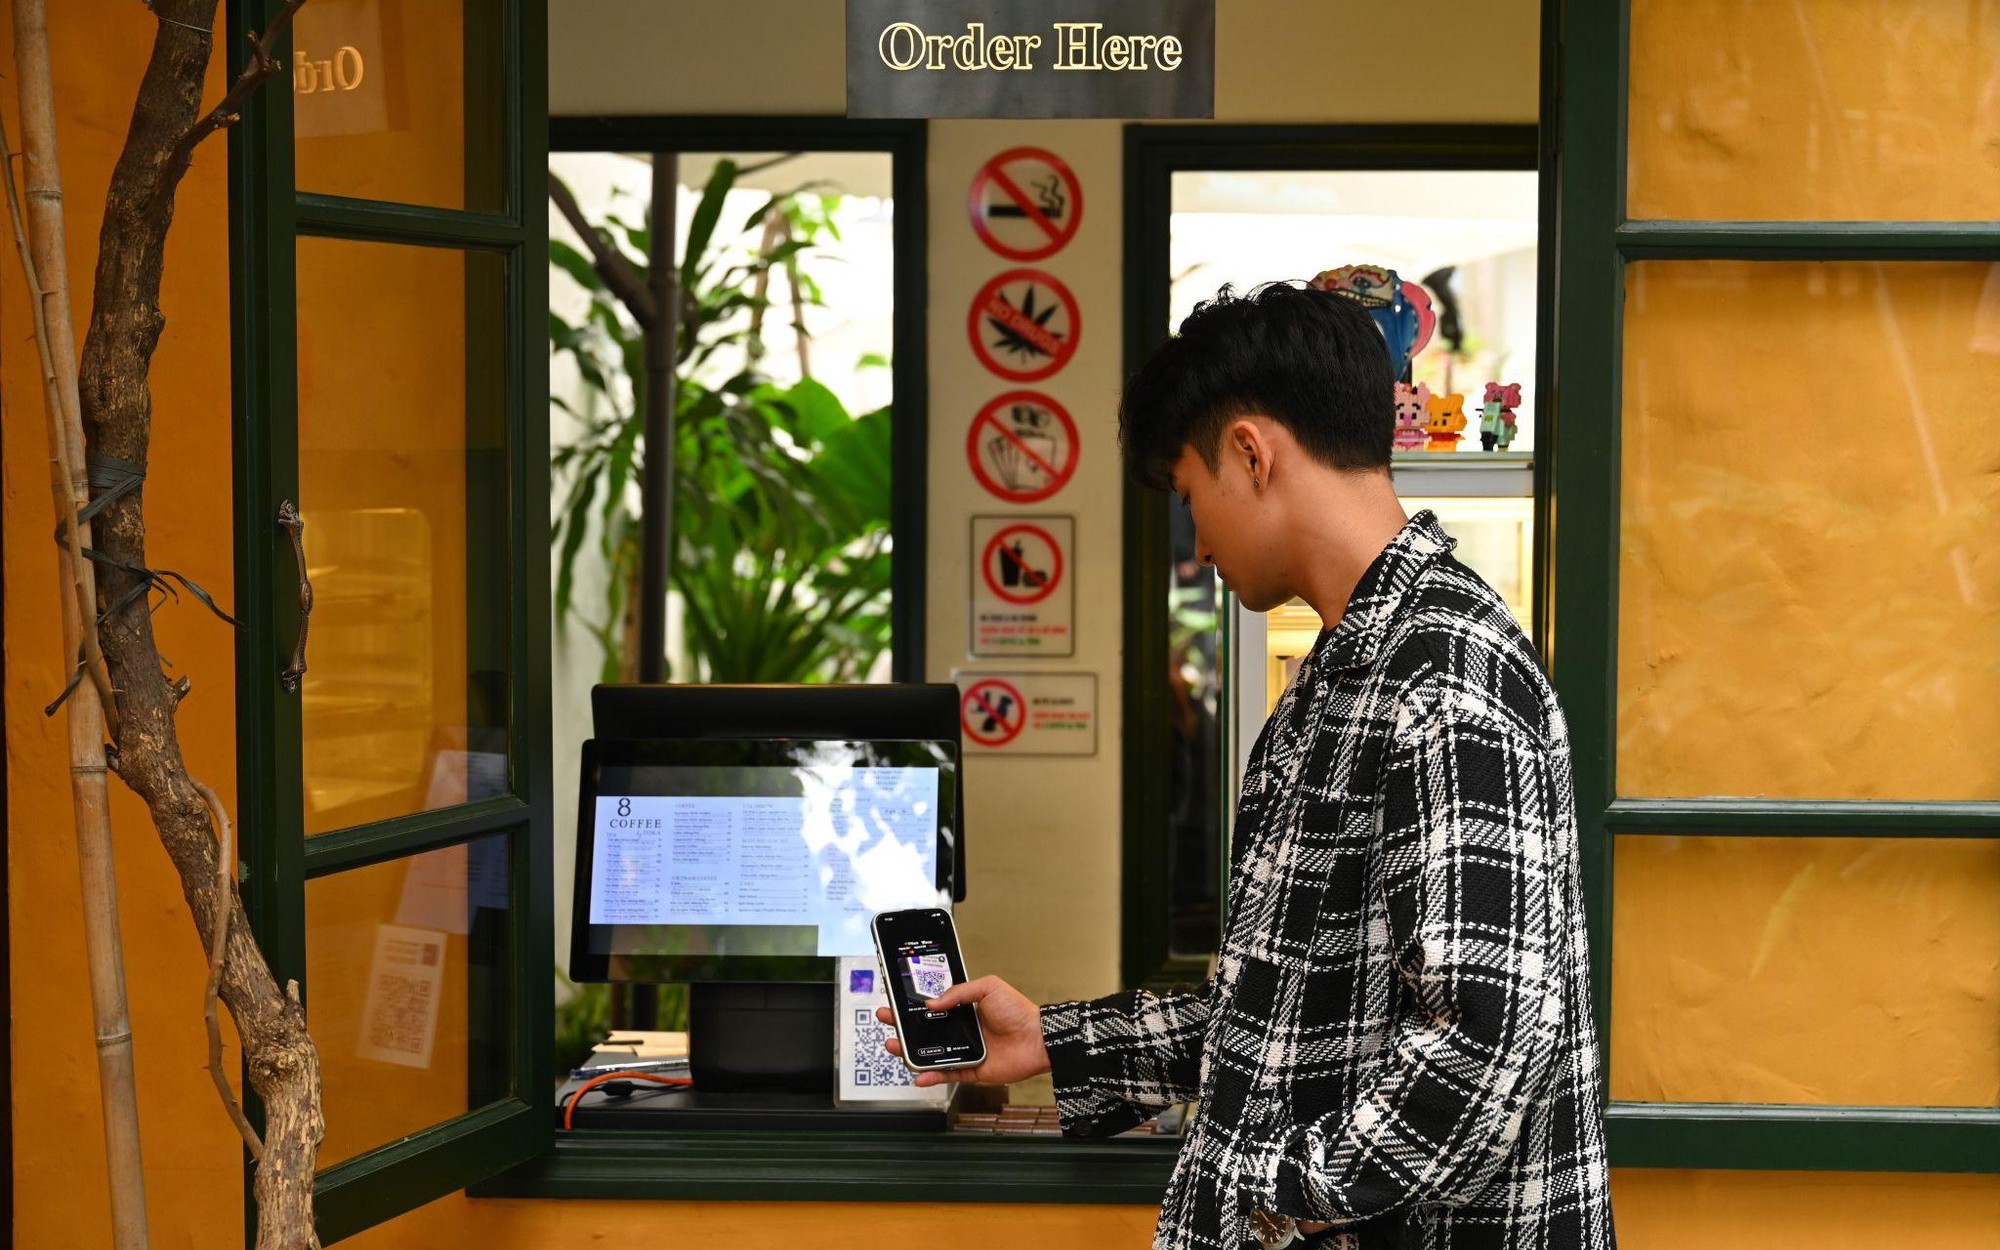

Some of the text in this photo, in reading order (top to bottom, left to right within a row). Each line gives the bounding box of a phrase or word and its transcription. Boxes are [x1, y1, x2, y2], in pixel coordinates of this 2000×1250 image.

[878, 22, 1183, 72] Order Here
[617, 797, 632, 817] 8
[609, 818, 662, 829] COFFEE
